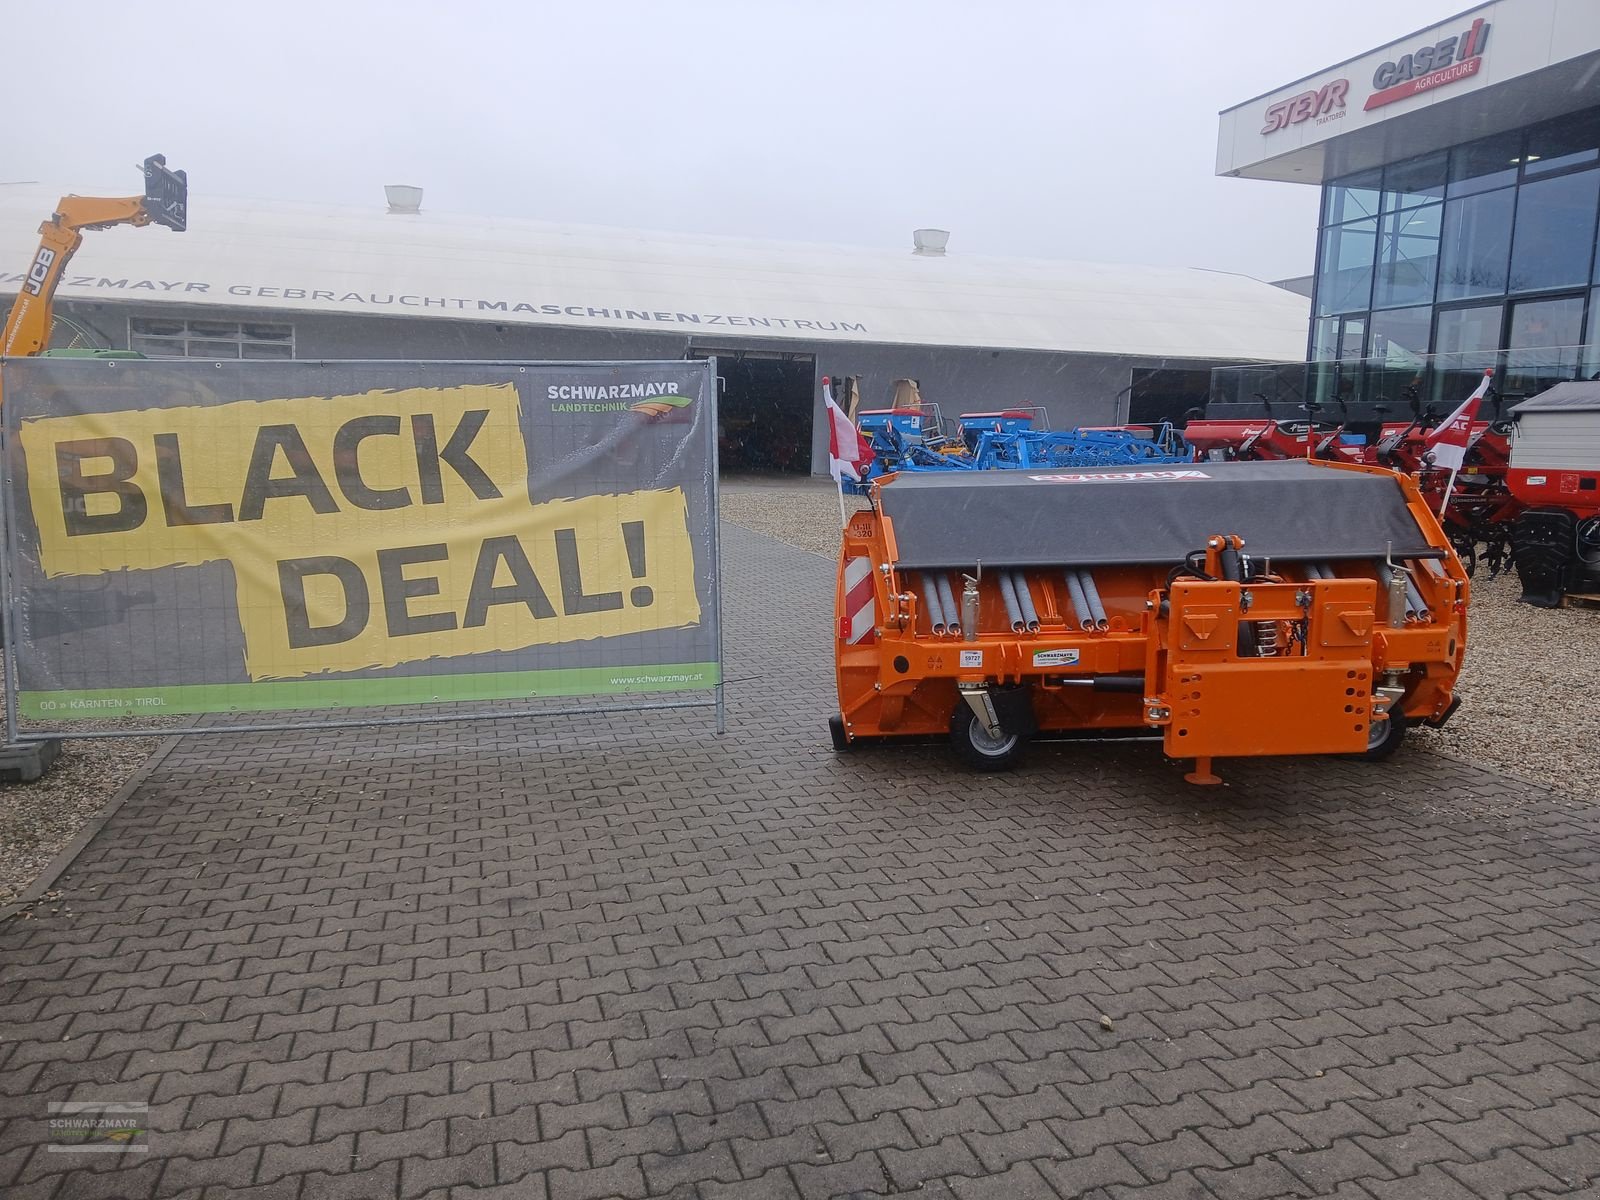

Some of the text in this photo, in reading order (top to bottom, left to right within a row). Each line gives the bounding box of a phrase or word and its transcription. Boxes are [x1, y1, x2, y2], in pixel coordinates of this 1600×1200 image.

[1373, 36, 1458, 90] CASE
[1414, 61, 1474, 91] AGRICULTURE
[1260, 79, 1349, 135] STEYR
[26, 247, 56, 296] JCB
[228, 285, 868, 333] GEBRAUCHTMASCHINENZENTRUM
[547, 382, 679, 400] SCHWARZMAYR
[551, 402, 627, 412] LANDTECHNIK
[54, 409, 504, 537] BLACK
[276, 520, 655, 650] DEAL!
[136, 697, 166, 707] TIROL
[609, 672, 703, 684] www.schwarzmayr.at
